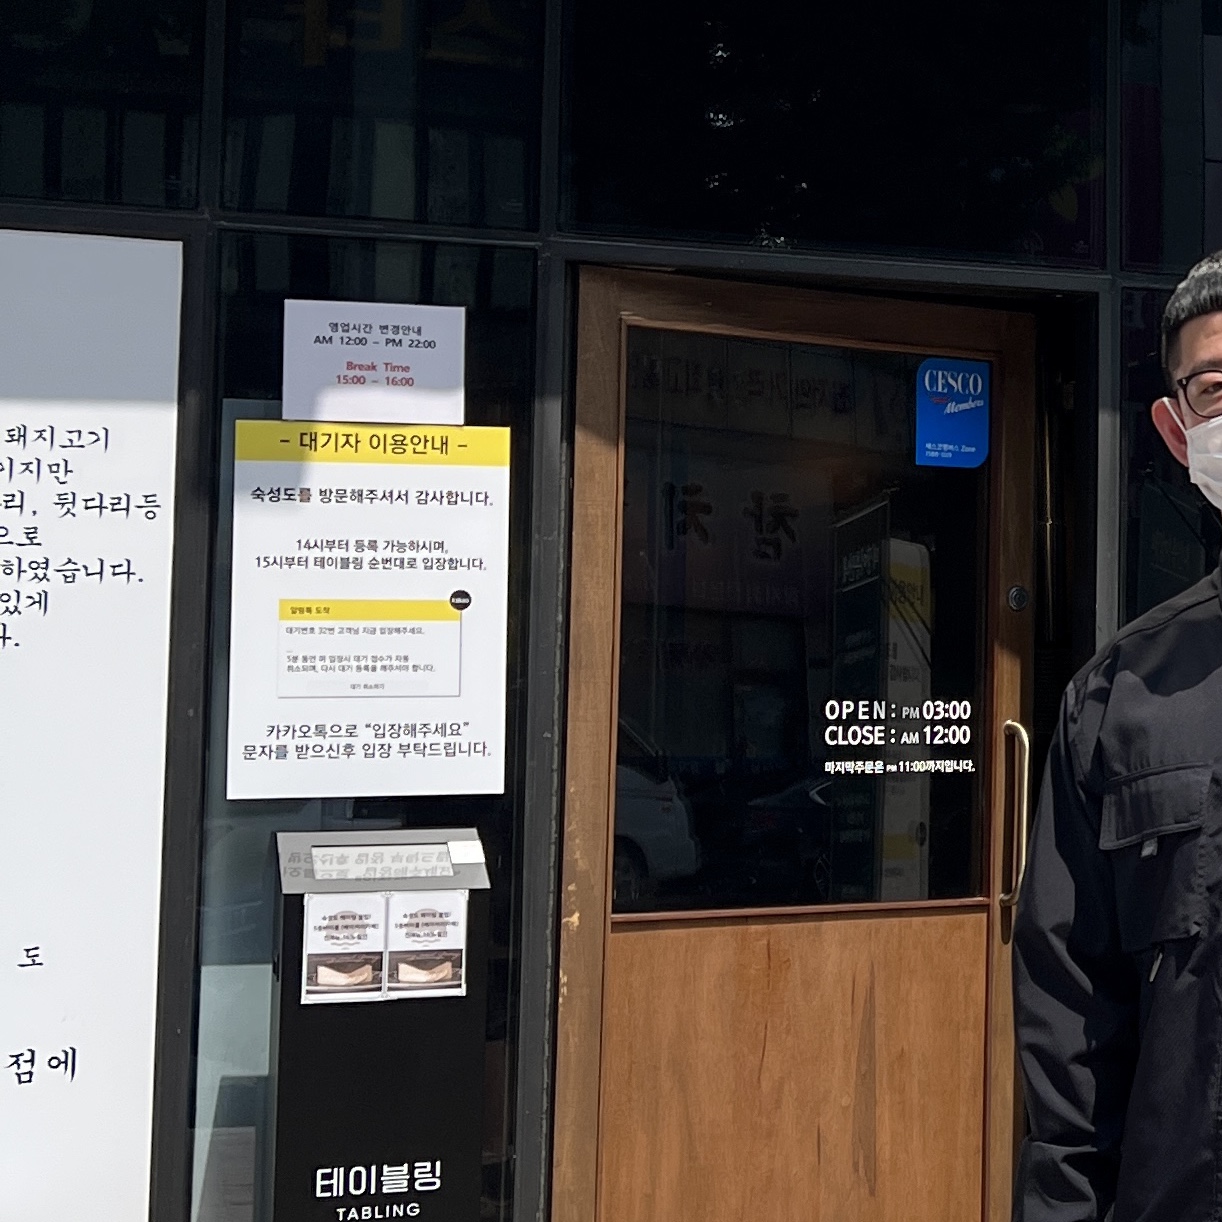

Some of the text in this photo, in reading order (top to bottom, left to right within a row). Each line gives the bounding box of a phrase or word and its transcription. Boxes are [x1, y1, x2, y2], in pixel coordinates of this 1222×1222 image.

[328, 322, 422, 336] 영업시간 변경안내
[313, 336, 333, 345] AM
[340, 336, 368, 346] 12:00
[385, 338, 403, 348] PM
[408, 338, 436, 349] 22:00
[346, 361, 410, 373] Break Time
[336, 374, 366, 385] 15:00
[385, 376, 415, 387] 16:00
[924, 369, 983, 396] CESCO
[4, 423, 110, 453] 돼지고기
[299, 432, 361, 454] 대기자
[369, 433, 449, 455] 이용안내
[53, 491, 162, 520] 뒷다리등
[250, 486, 494, 507] 숙성도를 방문해주셔서 감사합니다.
[296, 539, 449, 555] 14시부터 등록 가능하시며,
[0, 556, 144, 585] 하였습니다.
[255, 556, 487, 571] 15시부터 테이블링 순번대로 입장합니다.
[0, 589, 48, 616] 있게
[902, 706, 920, 719] PM
[922, 700, 971, 720] 03:00
[266, 723, 359, 741] 카카오톡으로
[900, 732, 920, 744] AM
[922, 725, 971, 745] 12:00
[242, 741, 491, 761] 문자를 받으신후 입장 부탁드립니다.
[824, 761, 885, 774] 마지막주문은
[898, 759, 976, 773] 11:00까지입니다.
[17, 946, 44, 968] 도
[315, 1160, 441, 1198] 테이블링
[335, 1202, 421, 1222] TABLING
